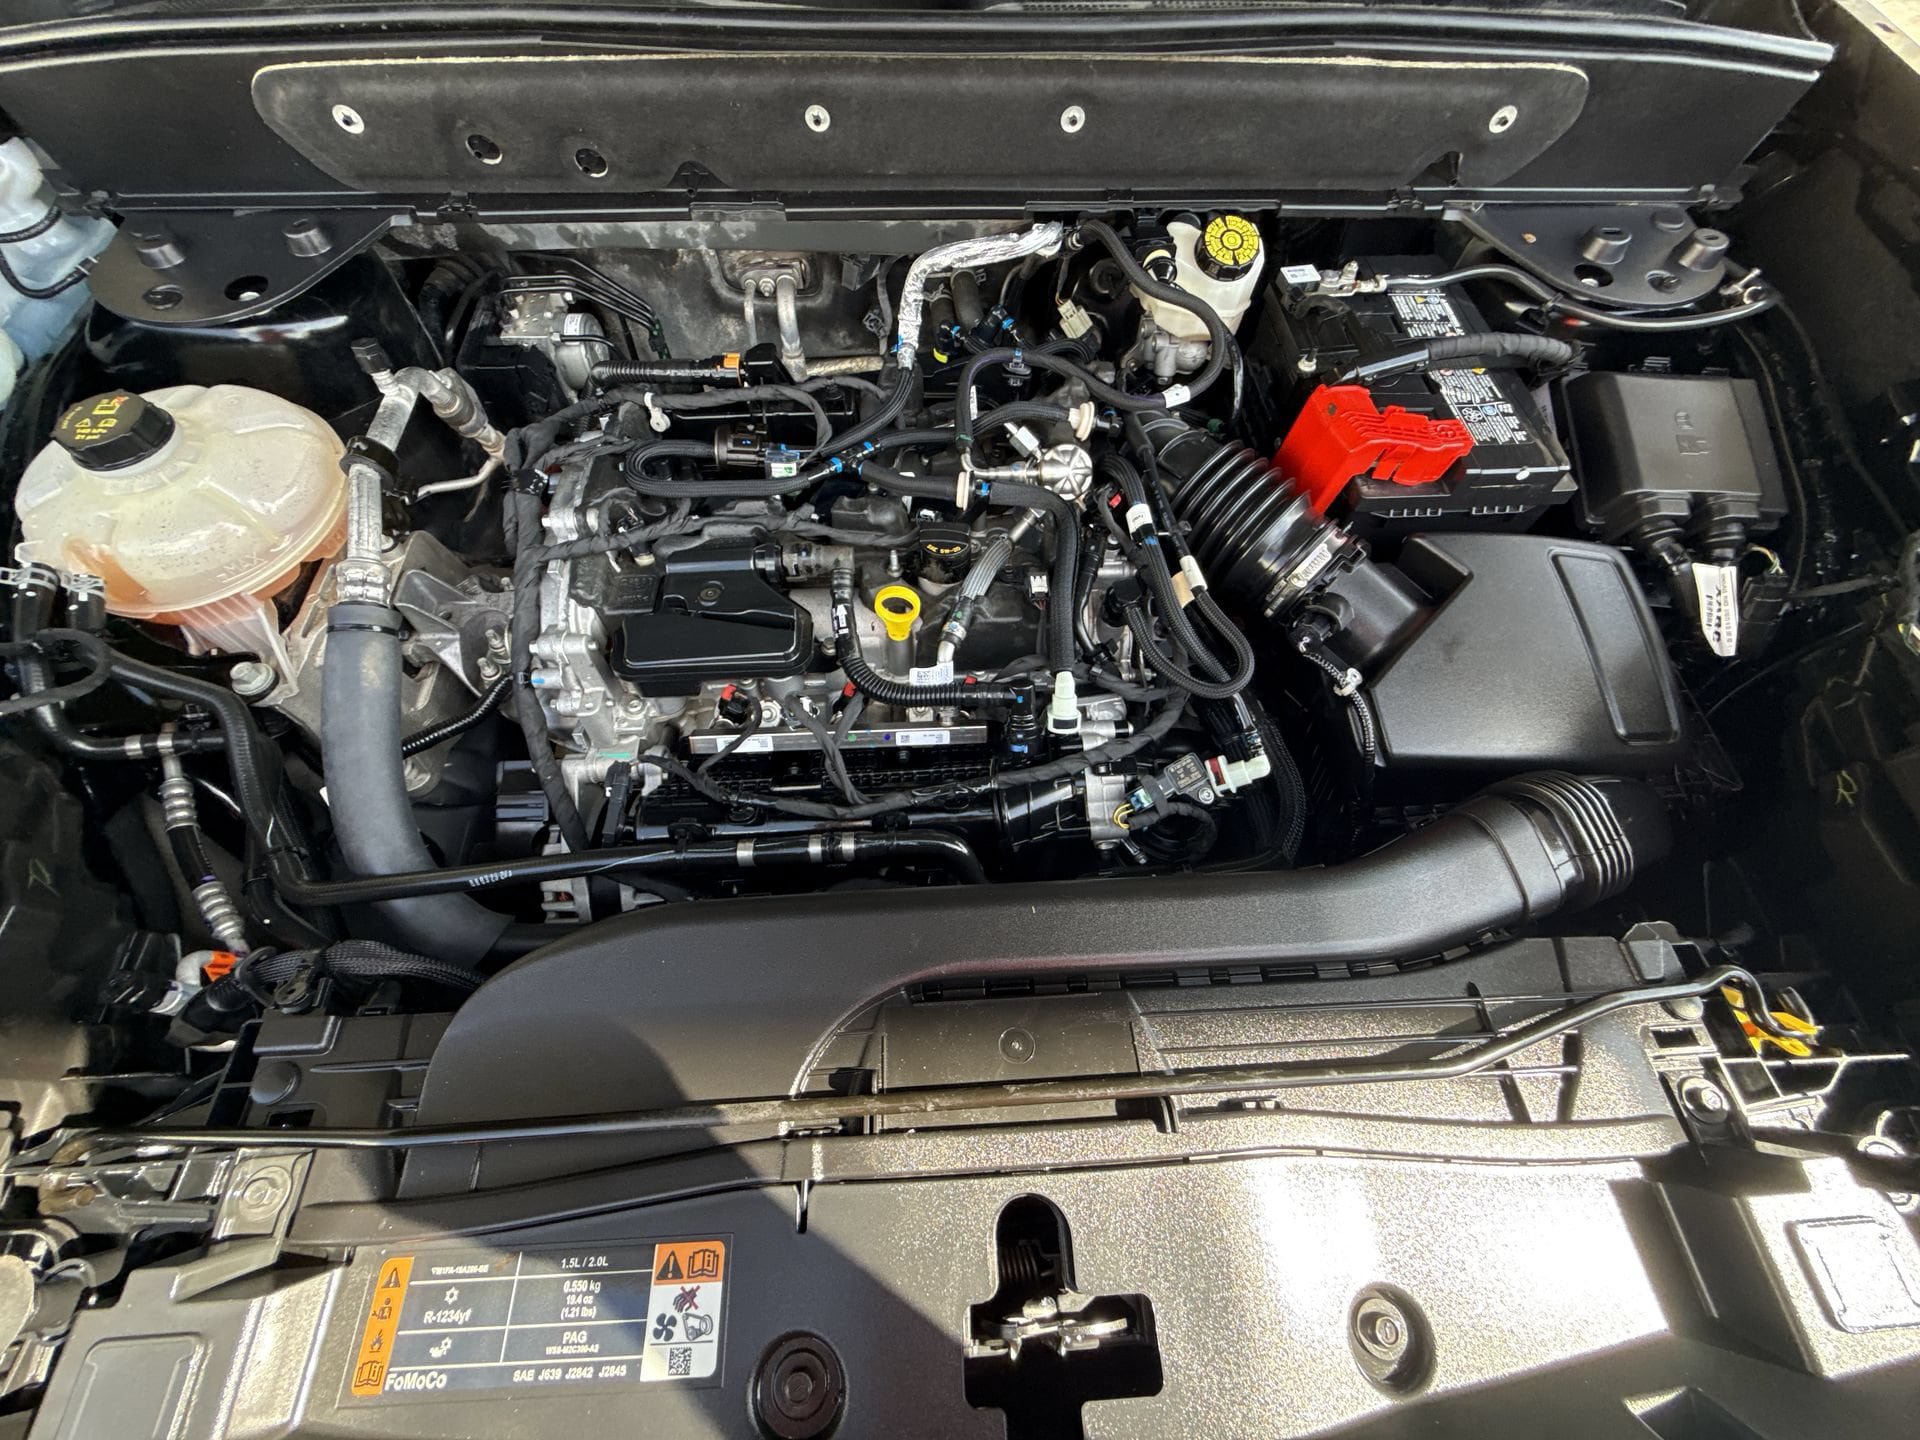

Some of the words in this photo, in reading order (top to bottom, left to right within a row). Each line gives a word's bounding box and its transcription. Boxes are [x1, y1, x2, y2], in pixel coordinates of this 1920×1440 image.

[560, 1256, 581, 1269] 1.5L
[588, 1255, 609, 1267] 2.0L
[563, 1280, 588, 1293] 0.550
[589, 1279, 602, 1294] kg
[566, 1294, 583, 1305] 19.4
[582, 1295, 594, 1304] oz
[423, 1307, 472, 1325] R-1234yf
[560, 1306, 581, 1320] (1.21
[580, 1305, 597, 1319] lbs)
[562, 1330, 588, 1344] PAG
[384, 1370, 448, 1391] FoMoCo
[512, 1368, 536, 1382] SAE
[538, 1367, 563, 1380] J639
[564, 1366, 594, 1379] J2842
